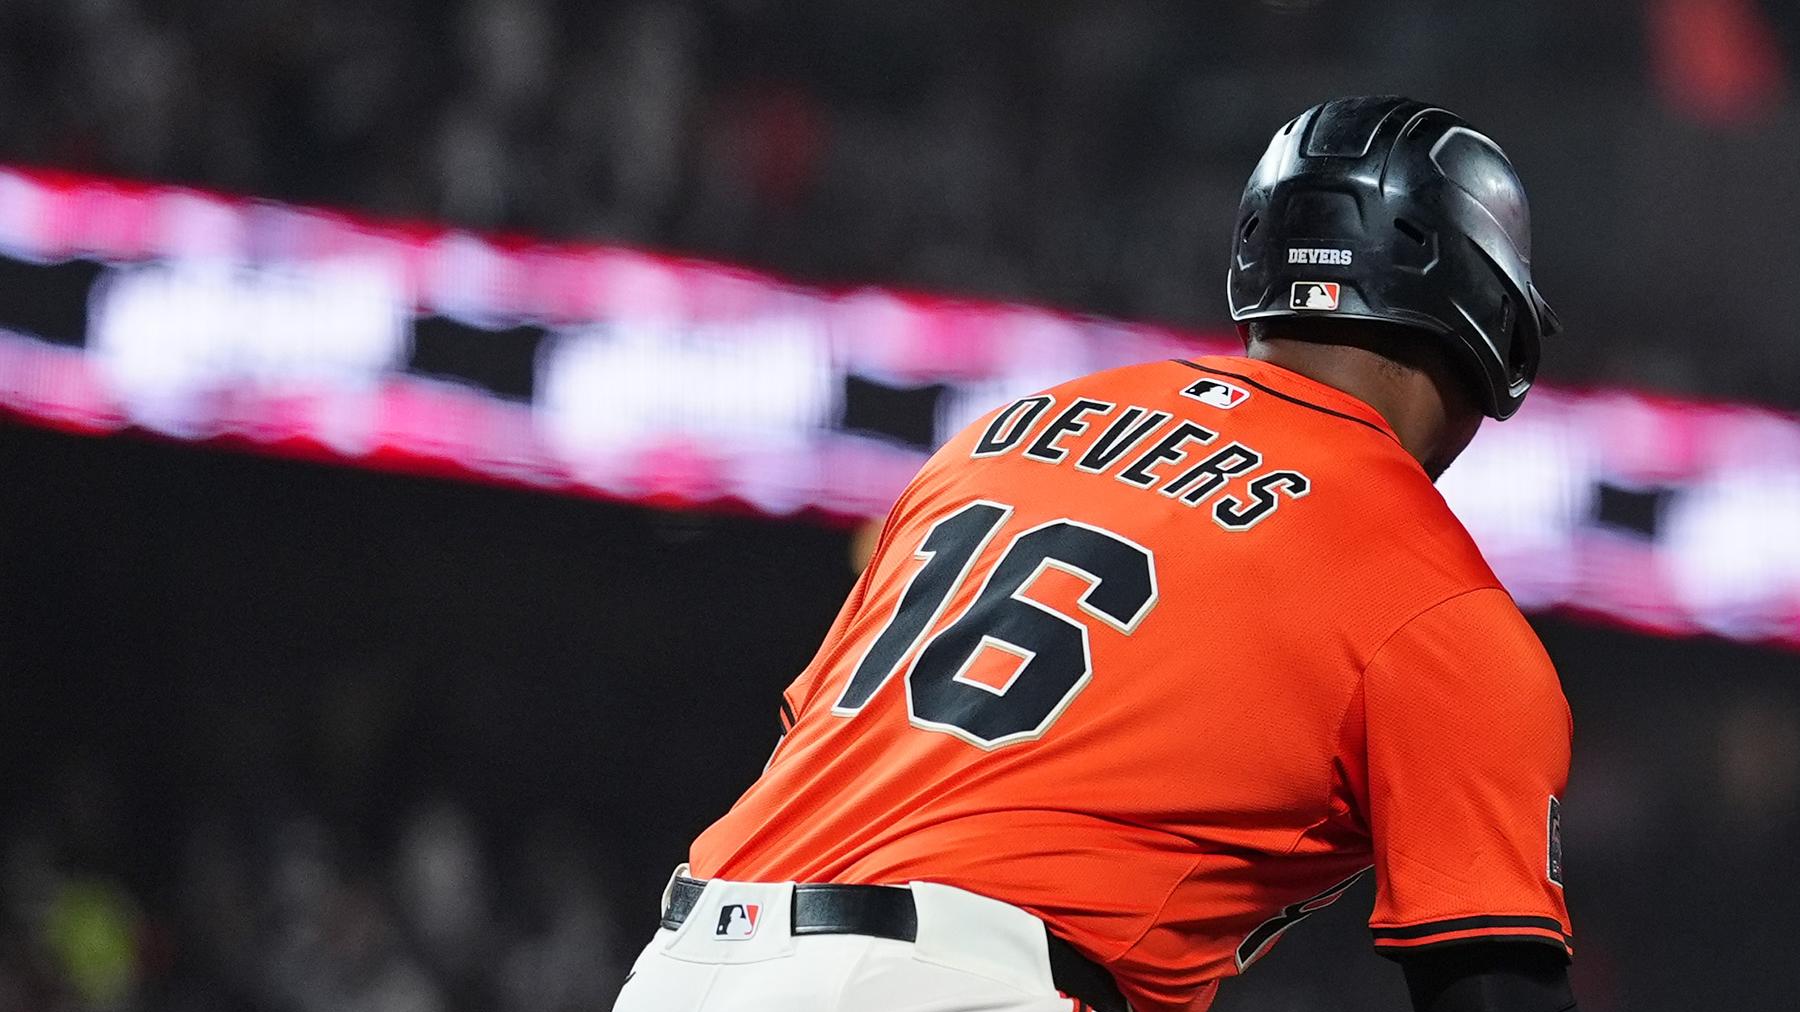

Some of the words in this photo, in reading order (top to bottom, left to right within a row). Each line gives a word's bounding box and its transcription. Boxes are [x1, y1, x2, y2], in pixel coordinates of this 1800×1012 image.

[1288, 248, 1352, 265] DEVERS
[970, 395, 1311, 532] DEVERS
[831, 499, 1160, 751] 16
